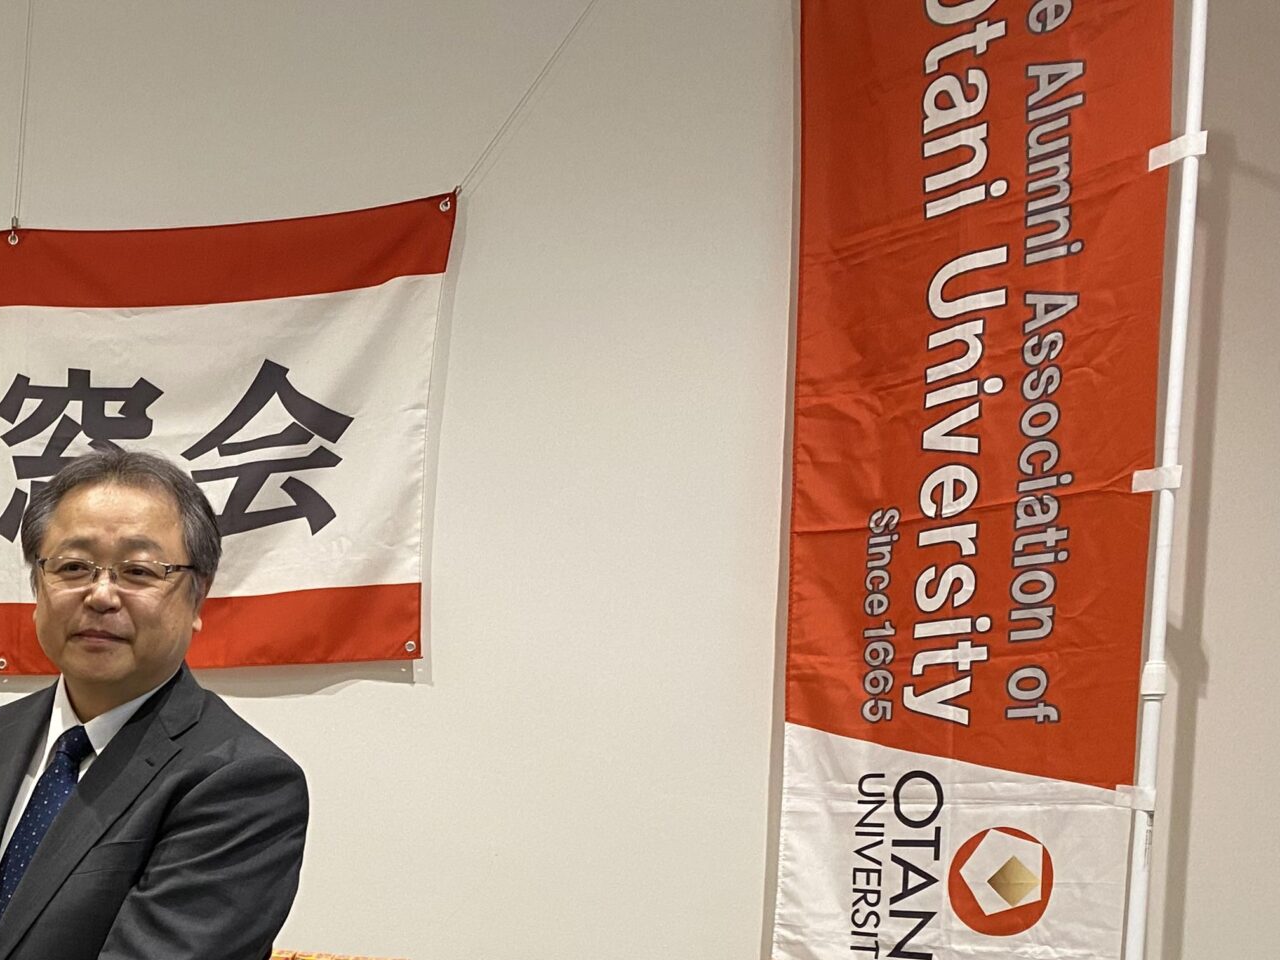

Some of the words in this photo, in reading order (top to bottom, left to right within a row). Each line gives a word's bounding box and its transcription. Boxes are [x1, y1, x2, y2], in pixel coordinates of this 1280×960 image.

[1023, 60, 1085, 266] Alumni
[903, 245, 1009, 727] University
[1008, 291, 1080, 643] Association
[863, 507, 901, 617] Since
[860, 626, 896, 723] 1665
[1005, 665, 1060, 725] of
